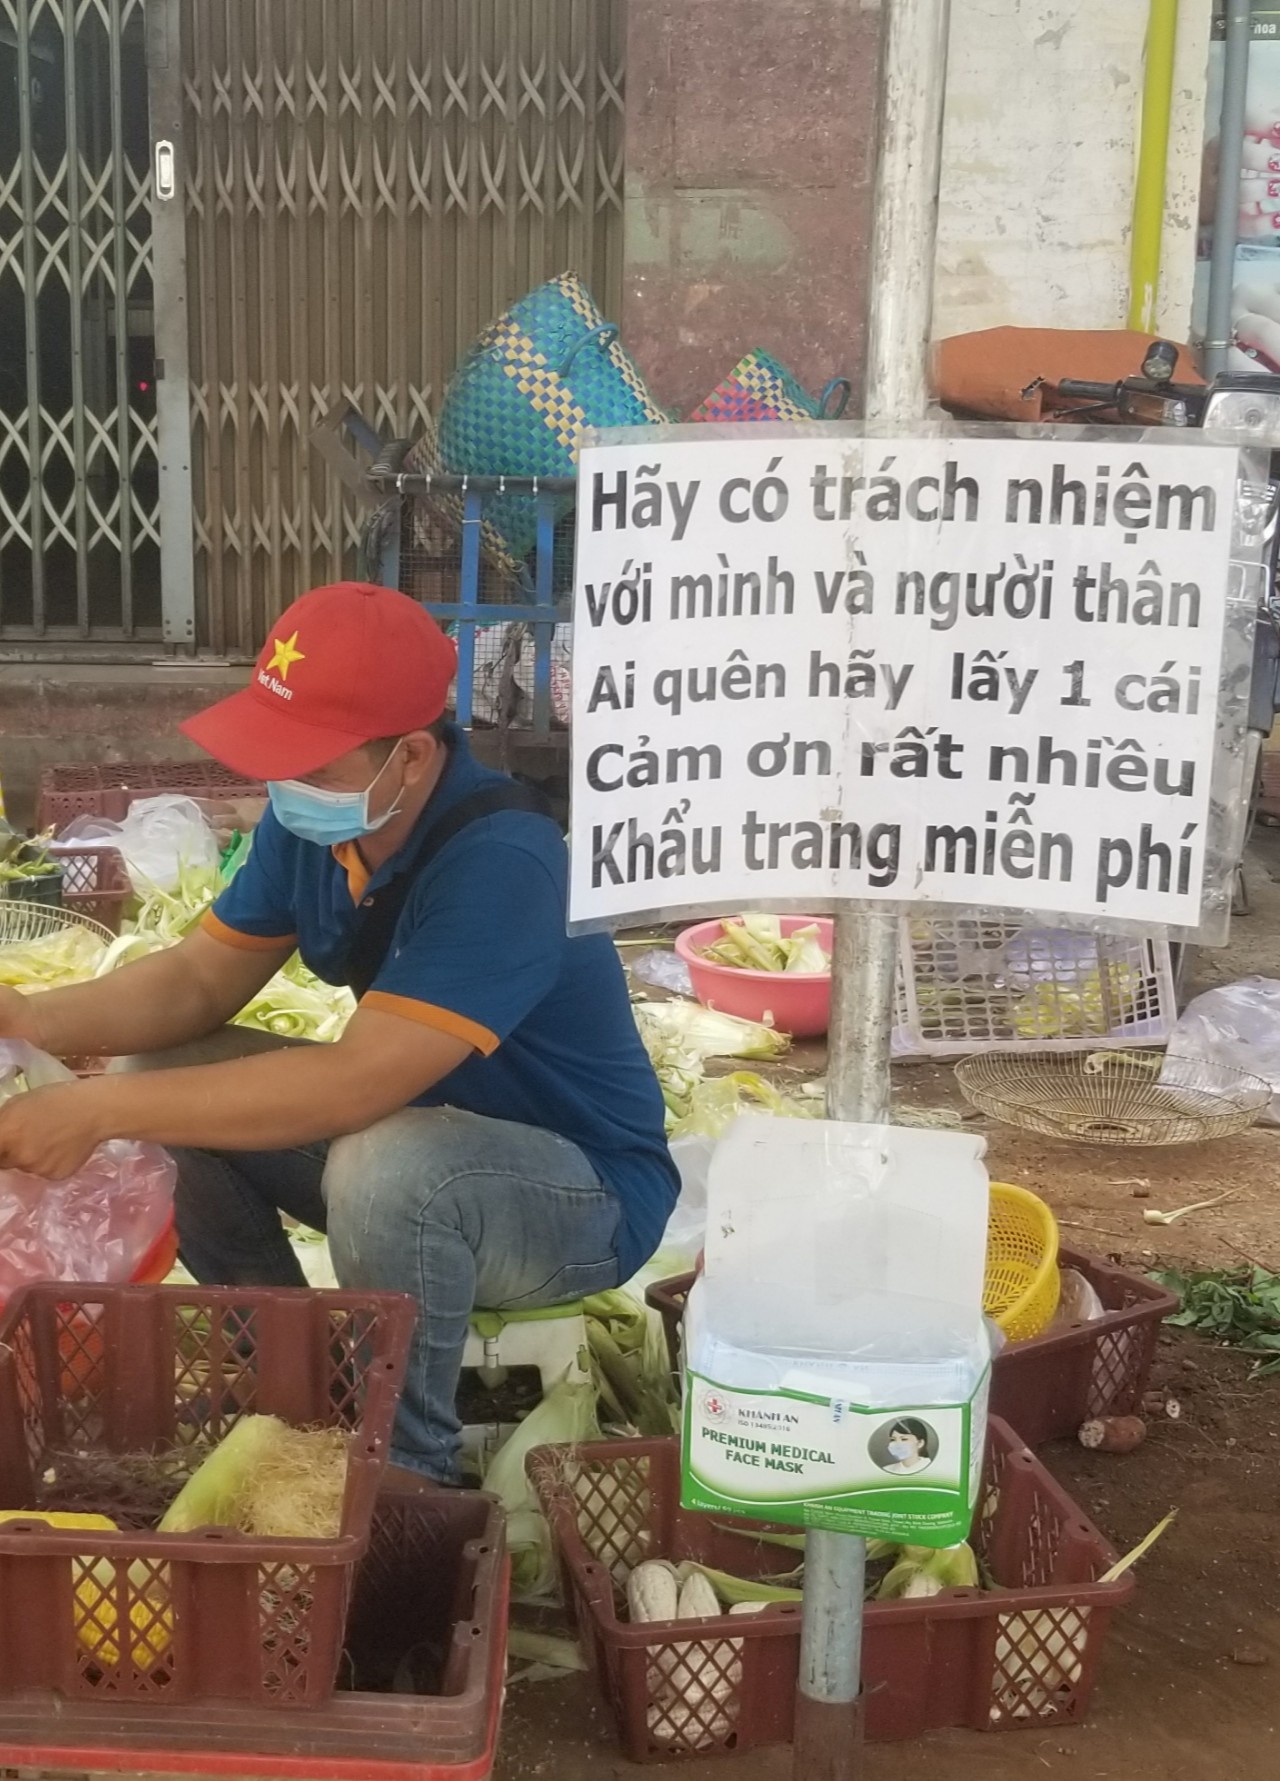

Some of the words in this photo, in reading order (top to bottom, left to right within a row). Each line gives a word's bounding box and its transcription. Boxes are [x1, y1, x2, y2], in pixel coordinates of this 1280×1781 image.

[592, 463, 701, 541] Hãy
[719, 456, 789, 523] có
[810, 461, 980, 524] trách
[1005, 462, 1217, 545] nhiệm
[584, 558, 653, 628] với
[669, 552, 795, 620] mình
[814, 550, 874, 616] và
[894, 553, 1055, 631] người
[1072, 561, 1201, 629] thân
[270, 677, 293, 700] Nam
[586, 660, 636, 713] Ai
[652, 649, 787, 717] quên
[808, 649, 915, 710] hãy
[951, 649, 1040, 716] lấy
[1059, 660, 1091, 708] 1
[1115, 660, 1202, 716] cái
[585, 734, 722, 793] Cảm
[746, 732, 832, 778] ơn
[859, 726, 964, 780] rất
[987, 734, 1196, 798] nhiều
[591, 797, 723, 889] Khẩu
[741, 810, 902, 887] trang
[923, 791, 1075, 883] miễn
[1095, 821, 1199, 903] phí
[702, 1427, 766, 1454] PREMIUM
[770, 1443, 836, 1464] MEDICAL
[783, 1414, 799, 1424] AN
[725, 1449, 760, 1467] FACE
[764, 1457, 804, 1475] MASK
